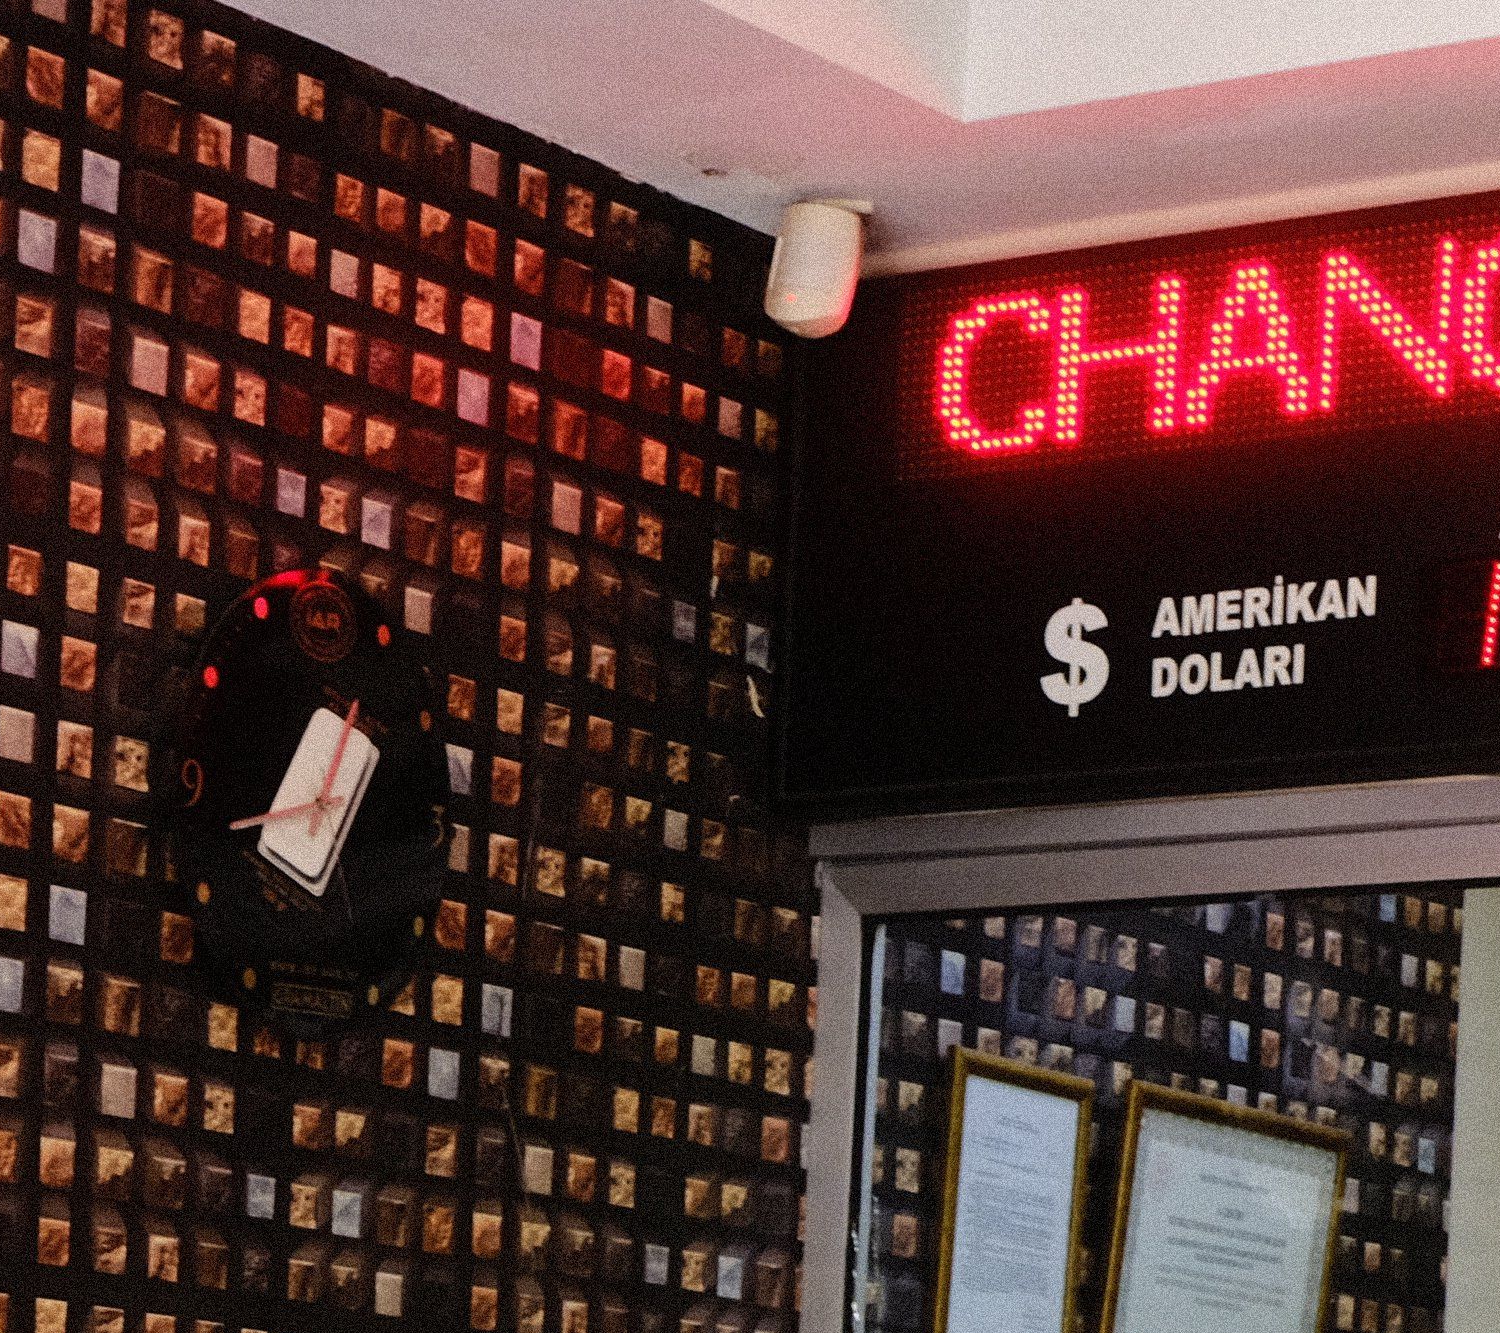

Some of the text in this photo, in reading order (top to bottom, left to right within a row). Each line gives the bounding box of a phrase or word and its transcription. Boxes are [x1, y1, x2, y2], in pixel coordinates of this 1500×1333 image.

[1152, 575, 1376, 637] AMERİKAN
[1040, 597, 1109, 716] $
[1152, 643, 1304, 698] DOLARI
